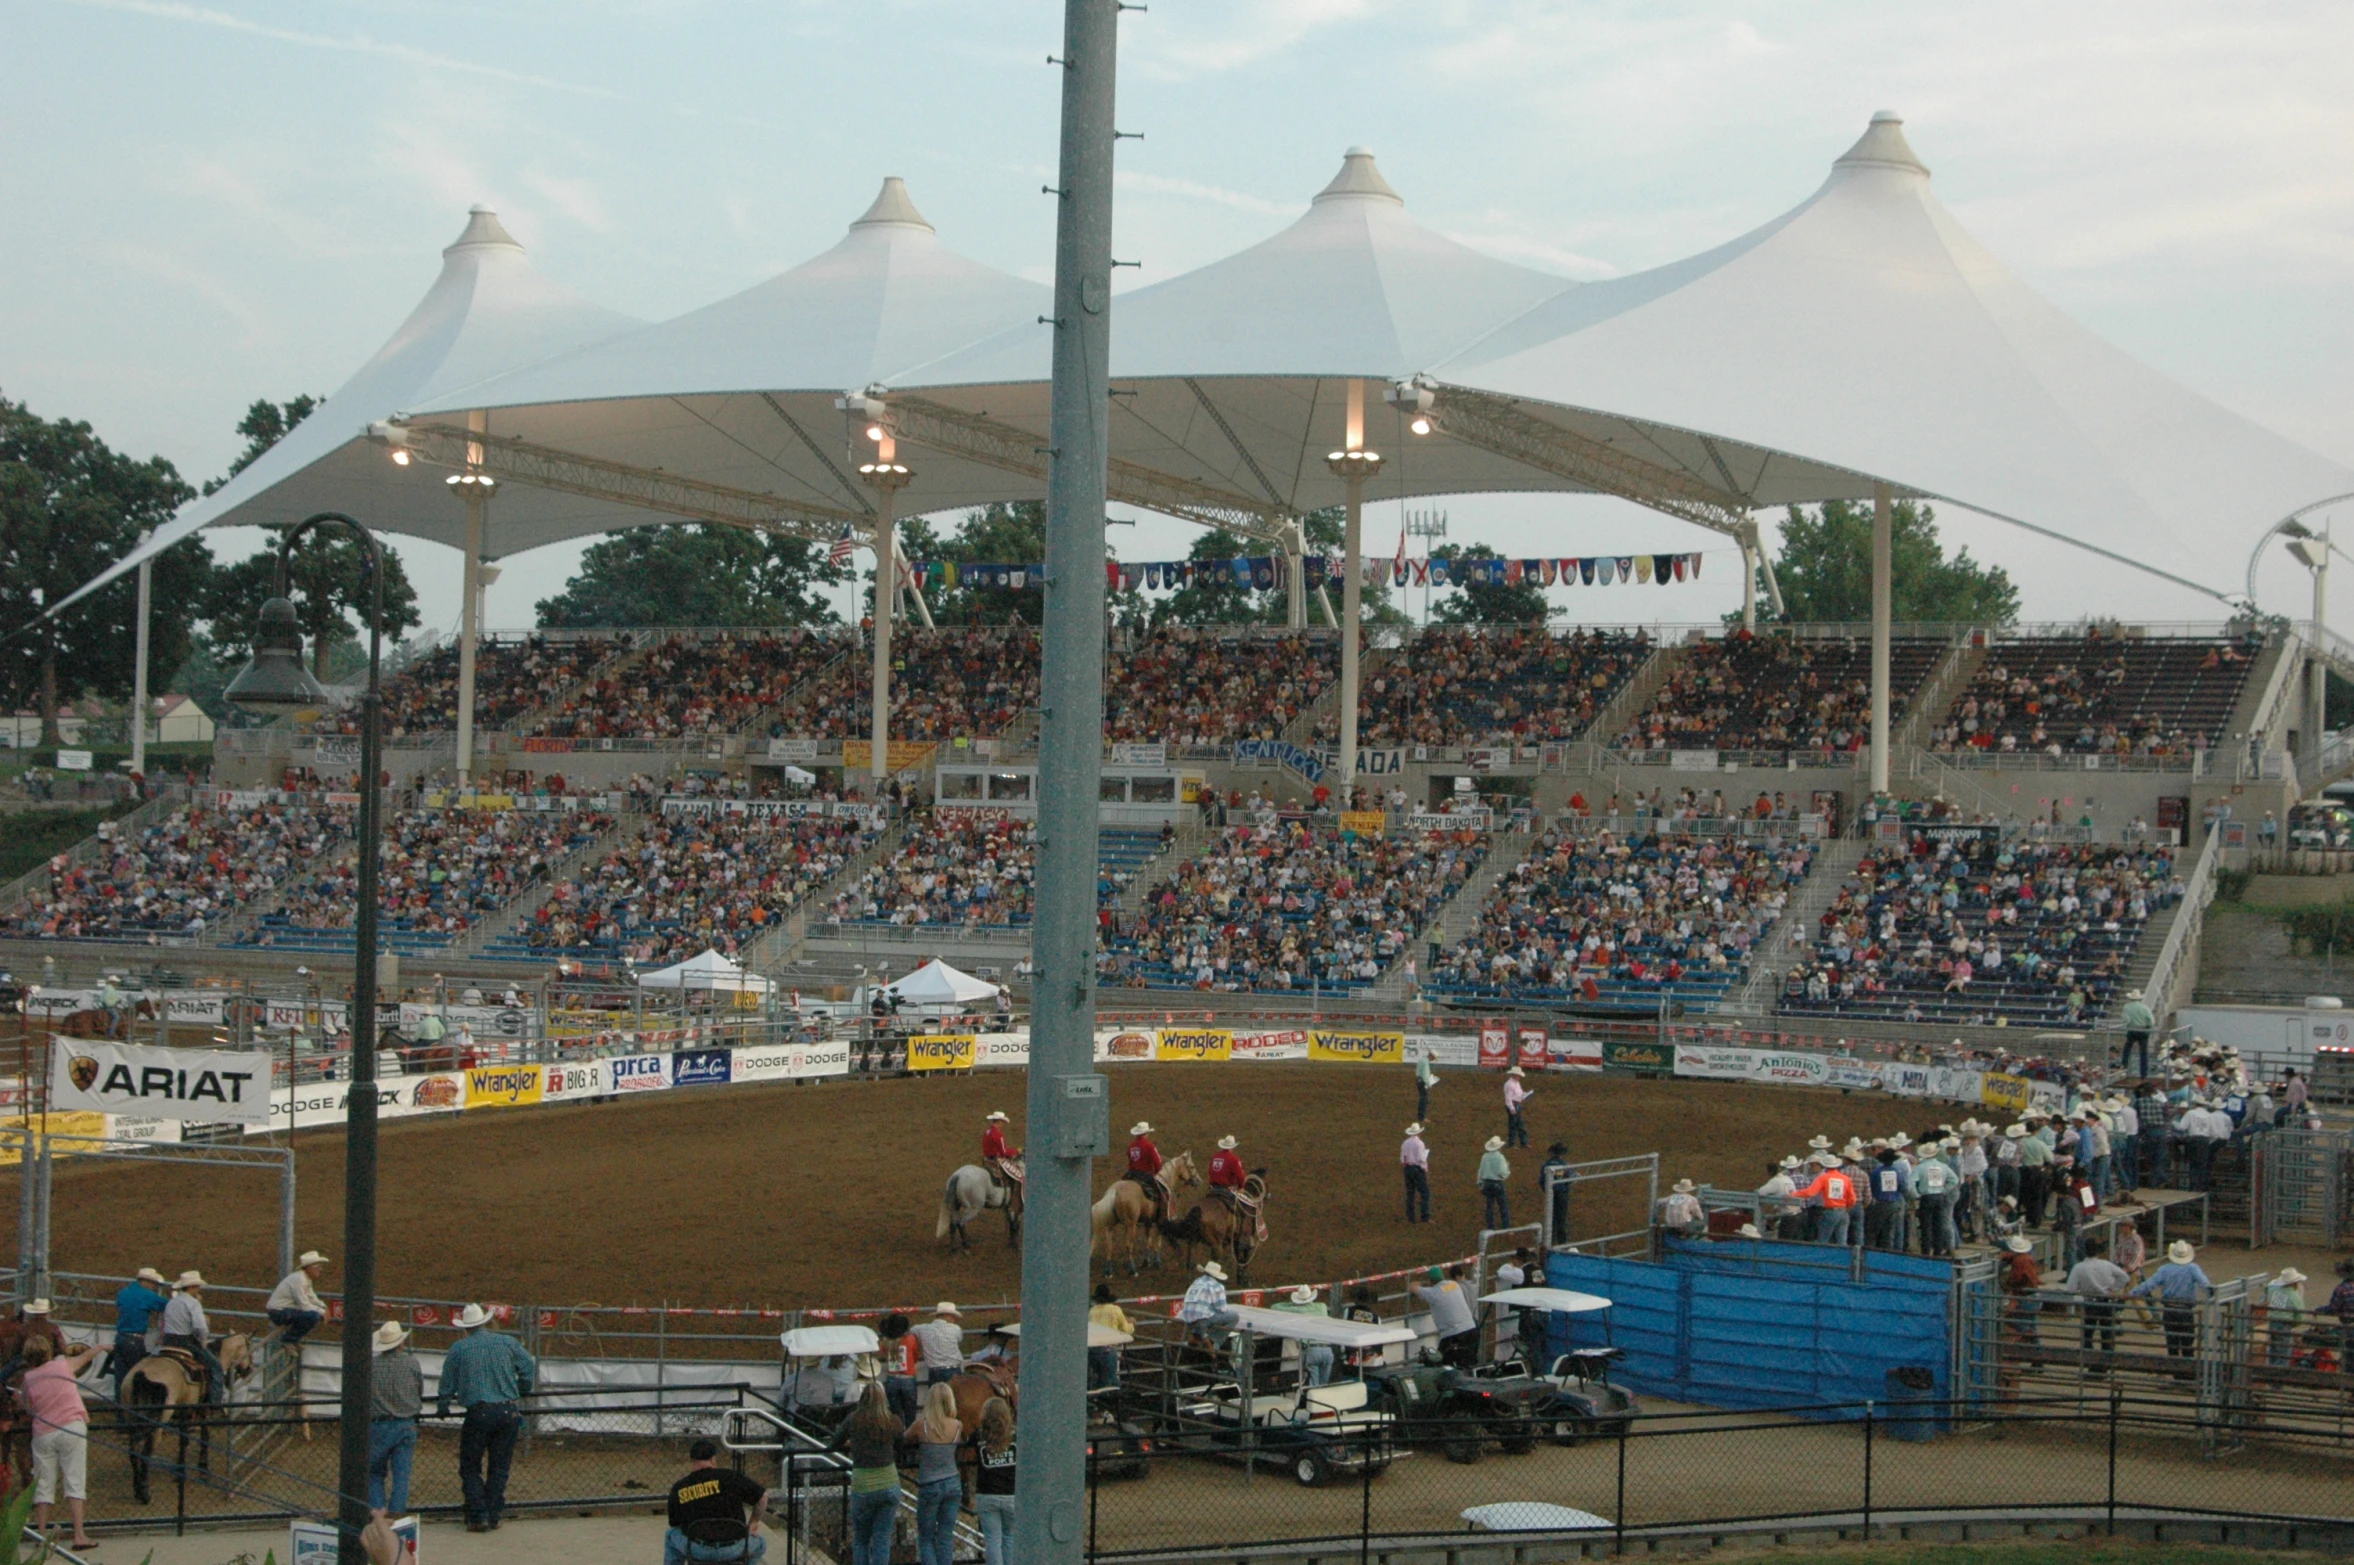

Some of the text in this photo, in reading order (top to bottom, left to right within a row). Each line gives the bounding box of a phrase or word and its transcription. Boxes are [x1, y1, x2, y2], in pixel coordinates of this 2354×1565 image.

[1234, 740, 1324, 782] KENTUCKY
[745, 803, 797, 819] TEXAS
[1409, 815, 1482, 828] NORTH DAKOTA
[913, 1037, 972, 1065] Wrangler
[990, 1043, 1030, 1054] DODG
[1161, 1031, 1227, 1057] Wrangler
[1231, 1030, 1308, 1051] RODEO
[1314, 1032, 1398, 1059] Wrangler
[745, 1056, 789, 1069] DODGE
[805, 1052, 847, 1065] DODGE
[101, 1063, 253, 1104] ARIAT
[567, 1070, 587, 1089] BIG
[590, 1068, 598, 1086] R
[1771, 1068, 1808, 1078] PIZZA
[470, 1070, 538, 1102] Wrangler
[269, 1097, 334, 1116] DODGE
[133, 1127, 156, 1138] GROUP
[678, 1479, 721, 1505] SECURITY
